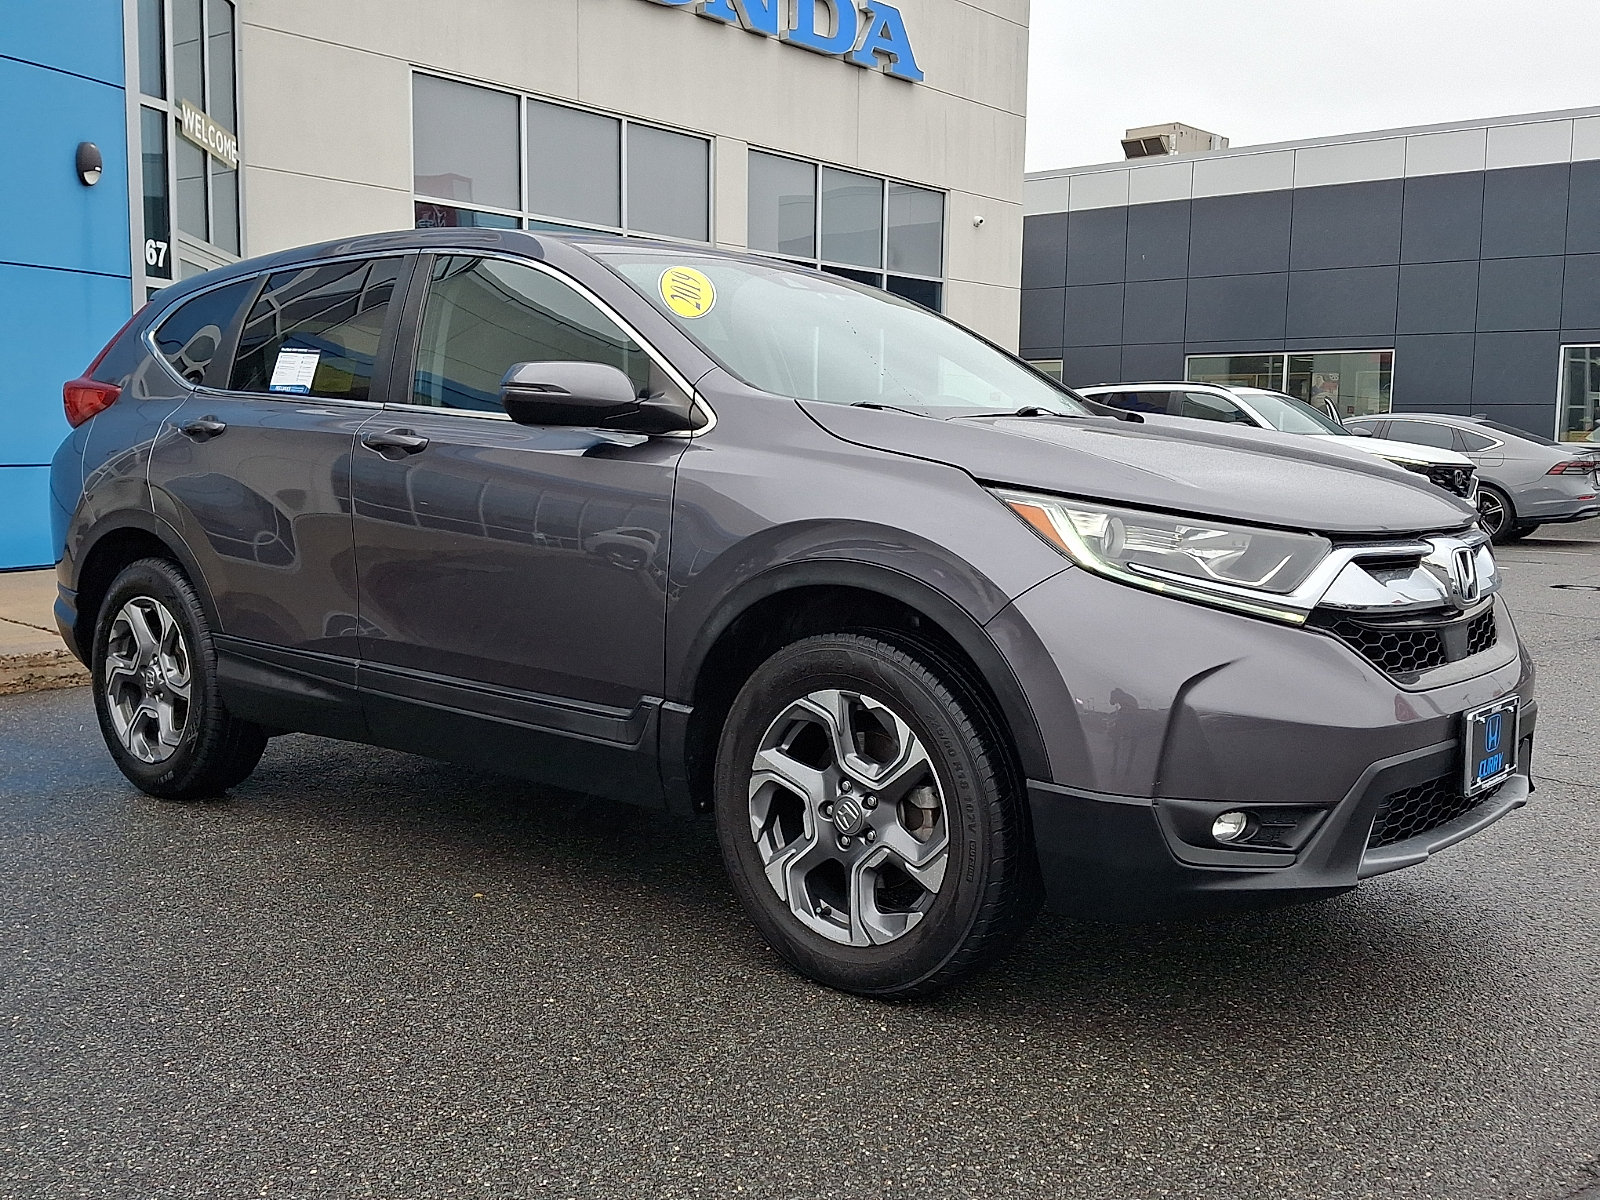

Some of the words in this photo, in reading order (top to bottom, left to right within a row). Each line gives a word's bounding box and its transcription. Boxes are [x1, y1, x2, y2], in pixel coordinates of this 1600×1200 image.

[666, 0, 924, 82] DA
[181, 103, 237, 165] WELCOME
[145, 238, 167, 268] 67
[670, 270, 701, 311] 2019
[1478, 751, 1504, 779] CURRY
